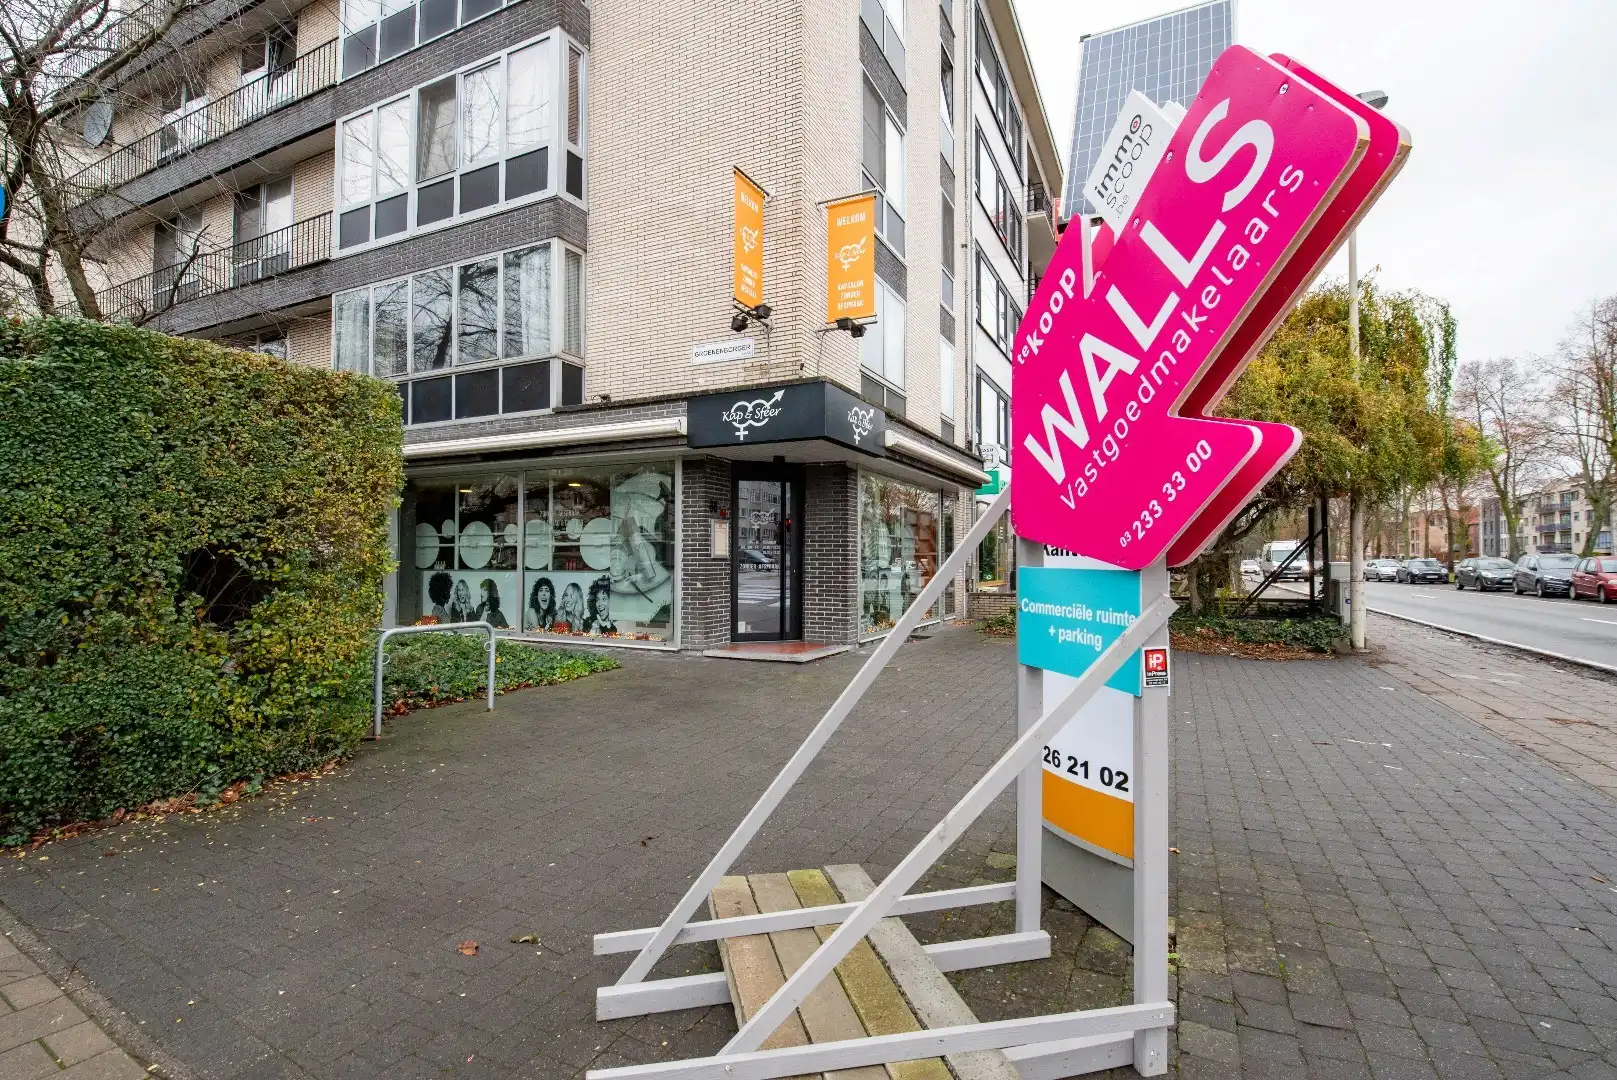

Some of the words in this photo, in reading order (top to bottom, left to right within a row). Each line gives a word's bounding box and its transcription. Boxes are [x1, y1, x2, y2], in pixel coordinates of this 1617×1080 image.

[1094, 114, 1142, 199] immo
[1106, 123, 1153, 209] scoop
[836, 212, 866, 227] WELKOM
[1024, 98, 1275, 485] WALLS
[694, 344, 751, 357] GROENENBORGER
[1060, 164, 1304, 511] Vastgoedmakelaars
[722, 410, 744, 423] Kap
[745, 411, 752, 420] &
[754, 406, 783, 419] Sfeer
[1119, 531, 1132, 548] 03
[1132, 499, 1163, 541] 233
[1162, 470, 1186, 502] 33
[1186, 439, 1212, 473] 00
[1021, 597, 1093, 622] Commerciële
[1096, 609, 1137, 627] ruimte
[1048, 625, 1056, 637] +
[1058, 626, 1103, 651] parking
[1043, 745, 1061, 768] 26
[1066, 755, 1089, 780] 21
[1100, 766, 1129, 793] 02
